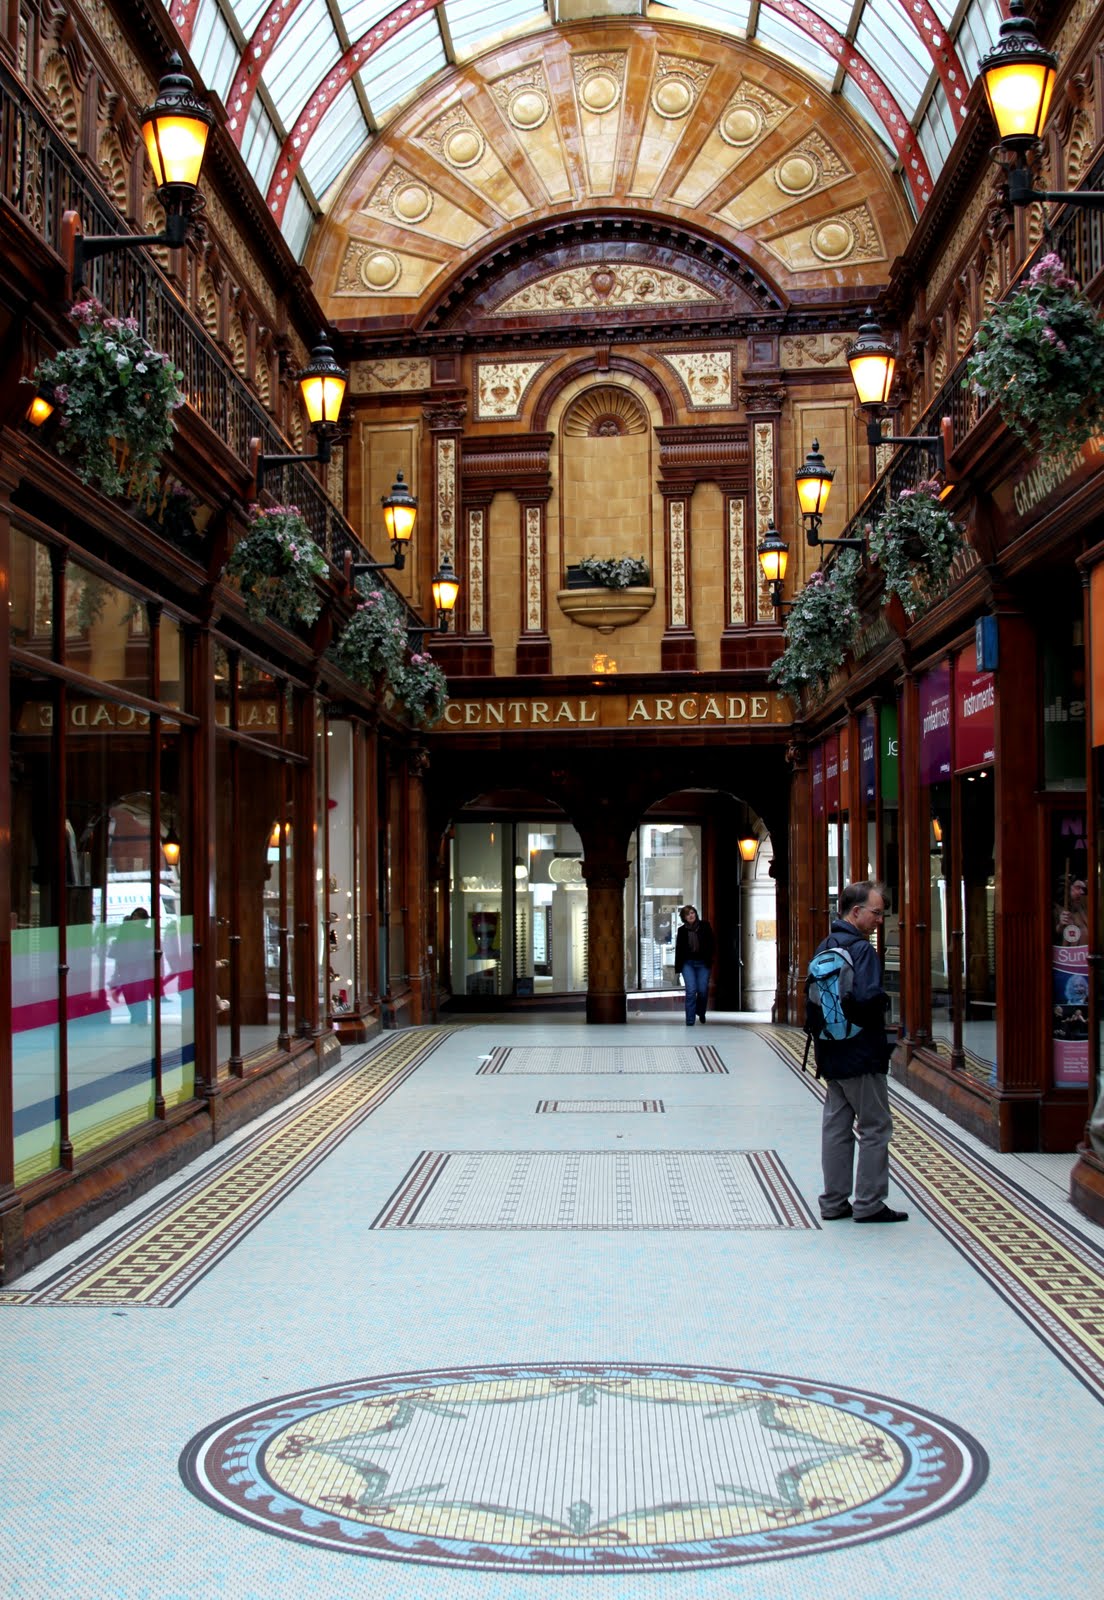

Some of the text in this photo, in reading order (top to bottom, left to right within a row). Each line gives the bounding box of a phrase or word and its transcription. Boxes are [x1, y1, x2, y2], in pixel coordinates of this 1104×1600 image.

[444, 697, 769, 725] CENTRAL ARCADE
[963, 682, 995, 718] instruments
[1058, 949, 1088, 963] Sun
